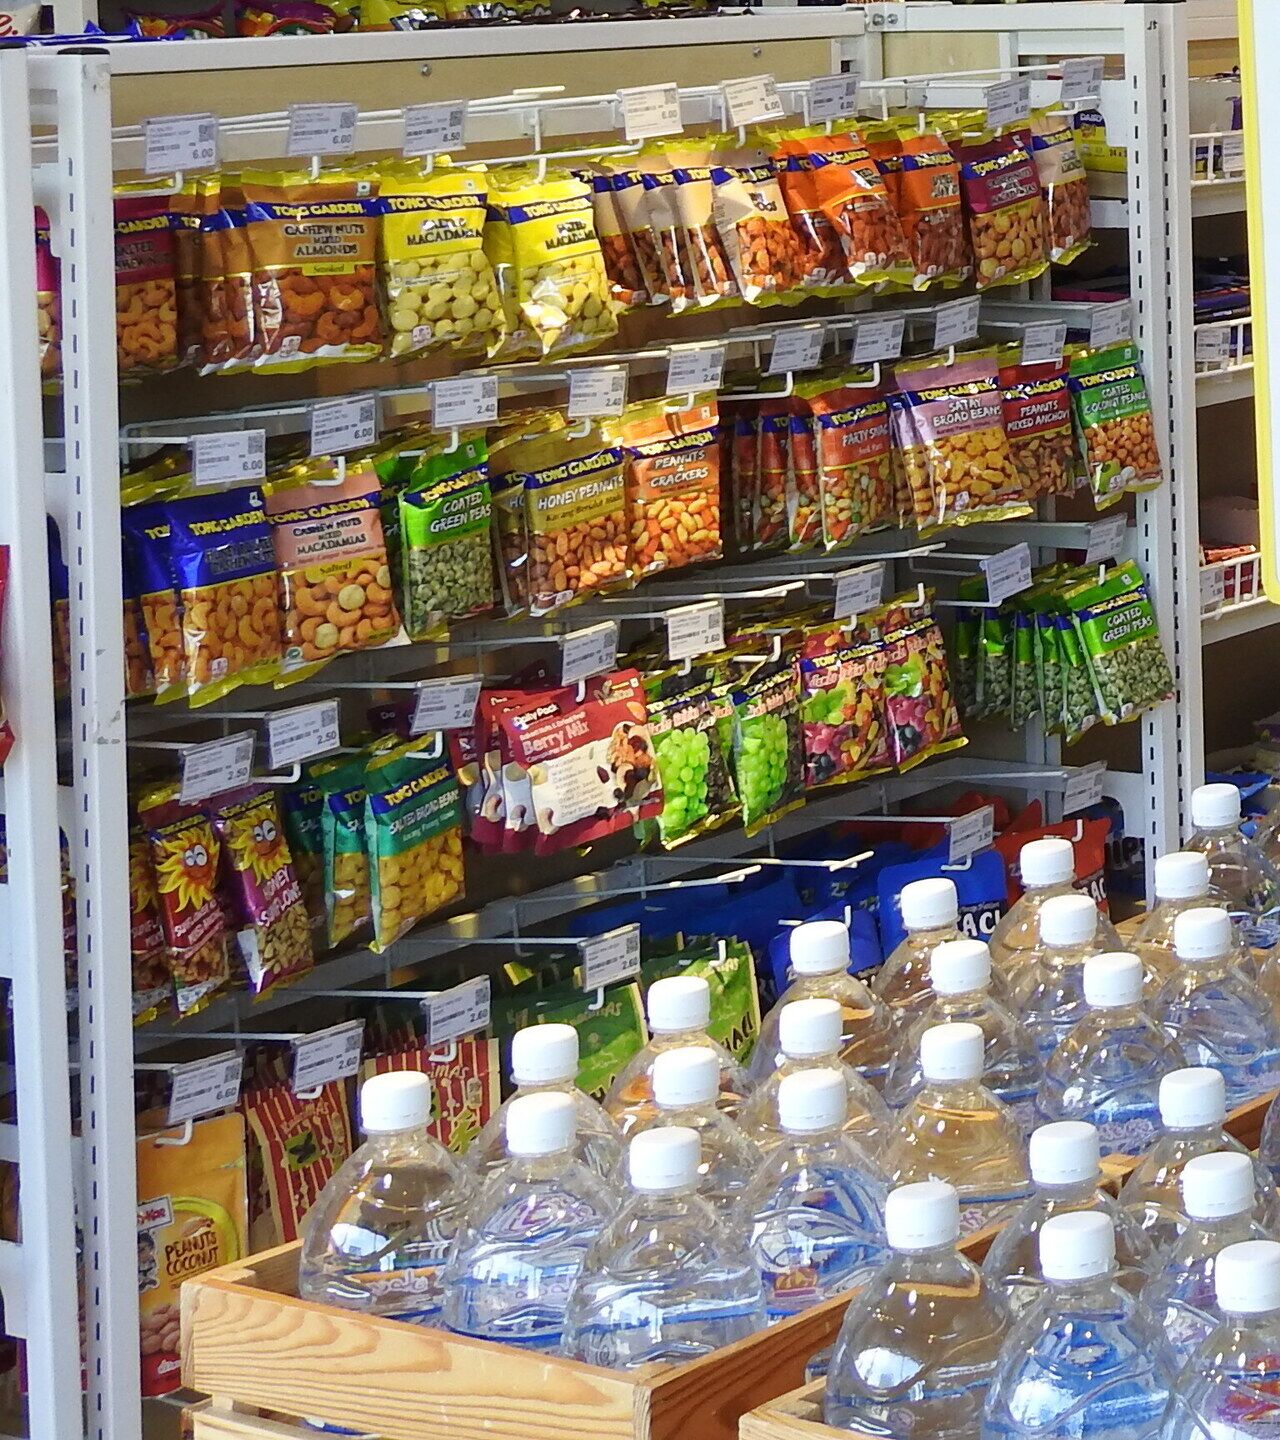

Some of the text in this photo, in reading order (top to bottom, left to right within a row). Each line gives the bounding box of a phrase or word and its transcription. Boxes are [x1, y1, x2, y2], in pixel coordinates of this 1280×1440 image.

[763, 101, 781, 112] 6.00
[661, 110, 679, 120] 6.00
[331, 134, 352, 145] 6.00
[191, 147, 215, 160] 6.00
[310, 203, 365, 217] GARDEN
[387, 195, 480, 211] TONG GARDEN
[284, 223, 365, 237] CASHEW NUTS
[295, 242, 358, 257] ALMONDS
[702, 372, 720, 384] 2.40
[604, 396, 623, 407] 2.40
[917, 388, 950, 402] TONG
[476, 404, 496, 415] 2.40
[949, 397, 982, 413] SATAY
[1020, 400, 1059, 417] PEANUTS
[932, 411, 970, 427] BROAD
[1006, 416, 1035, 432] MIXED
[353, 428, 373, 439] 6.00
[670, 431, 715, 452] GARDEN
[242, 460, 263, 472] 6.00
[654, 449, 706, 470] PEANUTS
[534, 452, 615, 484] TONG GARDEN
[650, 467, 710, 488] CRACKERS
[538, 487, 580, 510] HONEY
[579, 474, 624, 499] PEANUTS
[309, 498, 369, 518] GARDEN
[443, 491, 484, 514] COATED
[188, 510, 267, 537] TONG GARDEN
[292, 517, 363, 537] CASHEW NUTS
[429, 504, 493, 534] GREEN PEAS
[296, 533, 367, 556] MACADAMIAS
[319, 560, 353, 575] Salted
[1105, 607, 1143, 627] COATED
[1102, 616, 1153, 643] GREEN PEAS
[704, 633, 721, 645] 2.60
[316, 729, 338, 744] 2.50
[522, 730, 566, 757] Berry
[565, 718, 591, 741] Mix
[227, 766, 249, 781] 2.50
[409, 767, 450, 796] GARDEN
[470, 1008, 489, 1023] 2.60
[337, 1056, 358, 1071] 2.60
[216, 1087, 237, 1102] 6.60
[164, 1230, 218, 1259] PEANUTS
[165, 1246, 219, 1274] COCONUT
